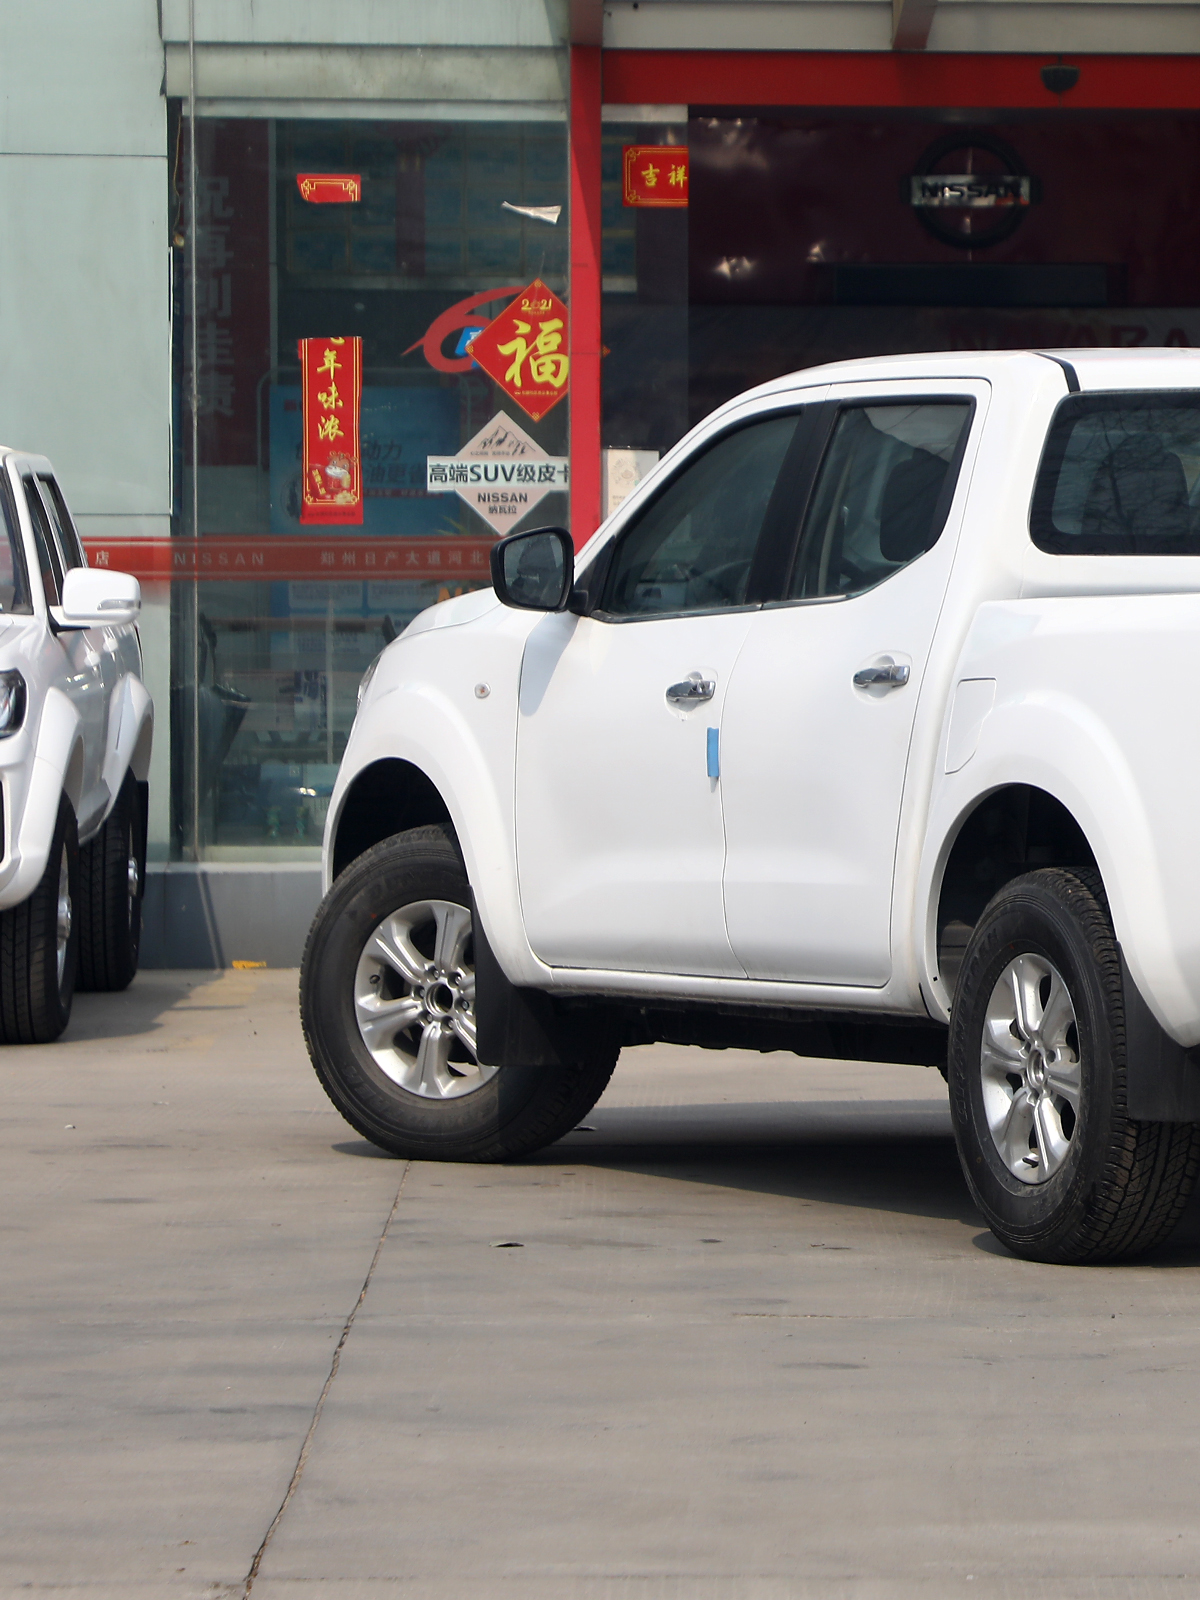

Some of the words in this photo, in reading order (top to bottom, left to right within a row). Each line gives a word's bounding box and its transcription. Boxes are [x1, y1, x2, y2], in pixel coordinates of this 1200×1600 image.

[641, 162, 688, 189] 吉祥
[920, 182, 1021, 199] NISSAN
[496, 317, 569, 388] 福
[316, 336, 345, 442] 年味浓
[477, 492, 528, 503] NISSAN
[488, 505, 518, 515] 纳瓦拉
[173, 551, 265, 567] NISSAN
